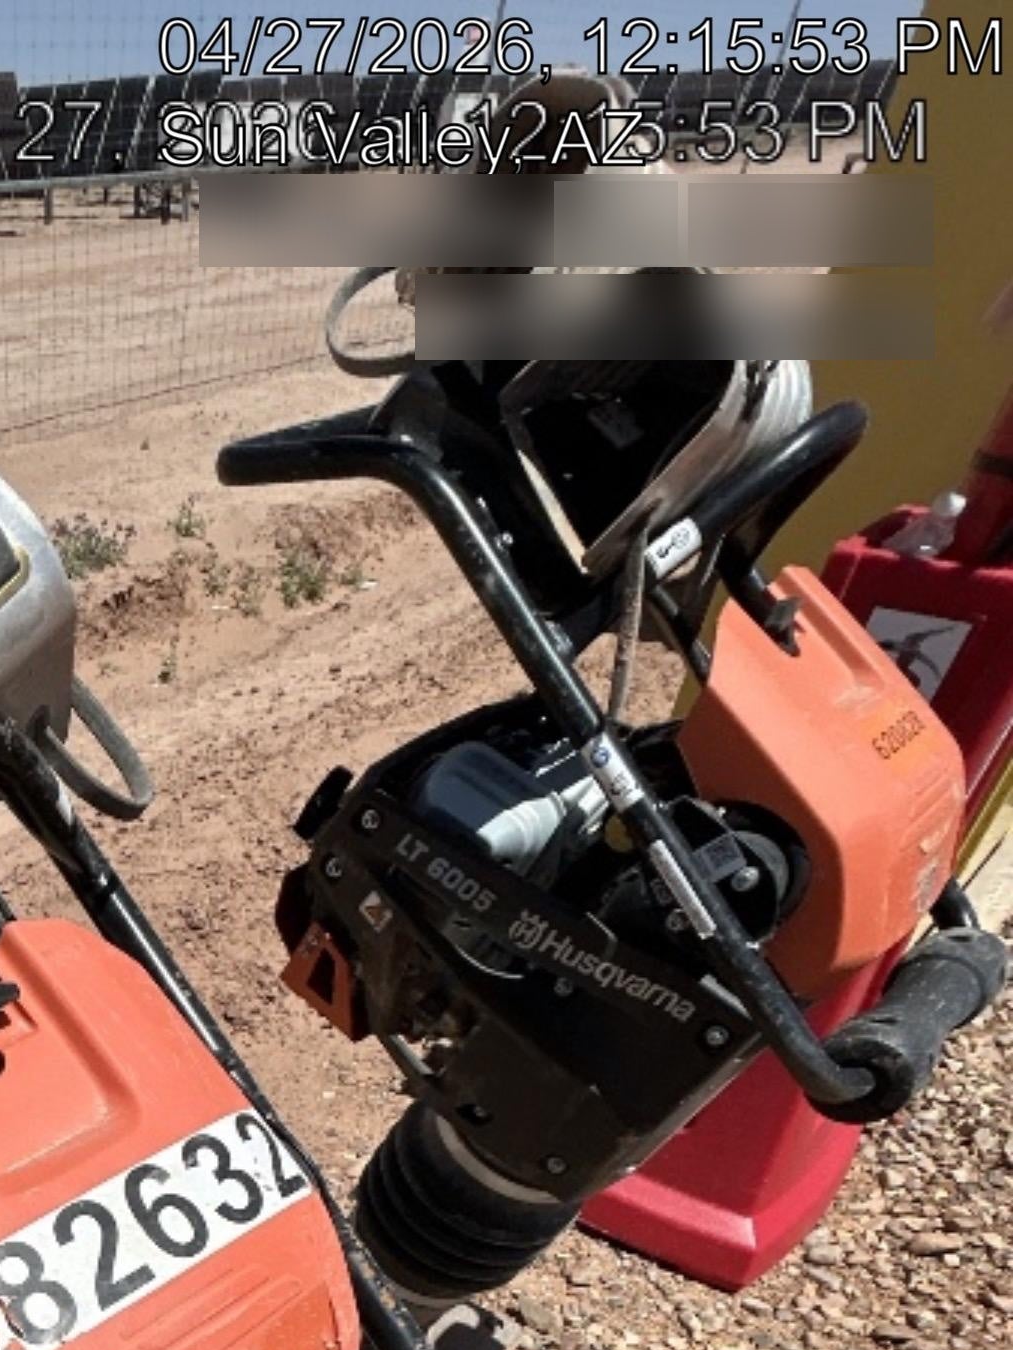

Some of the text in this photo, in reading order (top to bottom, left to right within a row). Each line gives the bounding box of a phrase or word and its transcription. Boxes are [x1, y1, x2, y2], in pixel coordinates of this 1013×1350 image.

[395, 833, 498, 912] LT 6005
[538, 928, 696, 1022] Husqvarna
